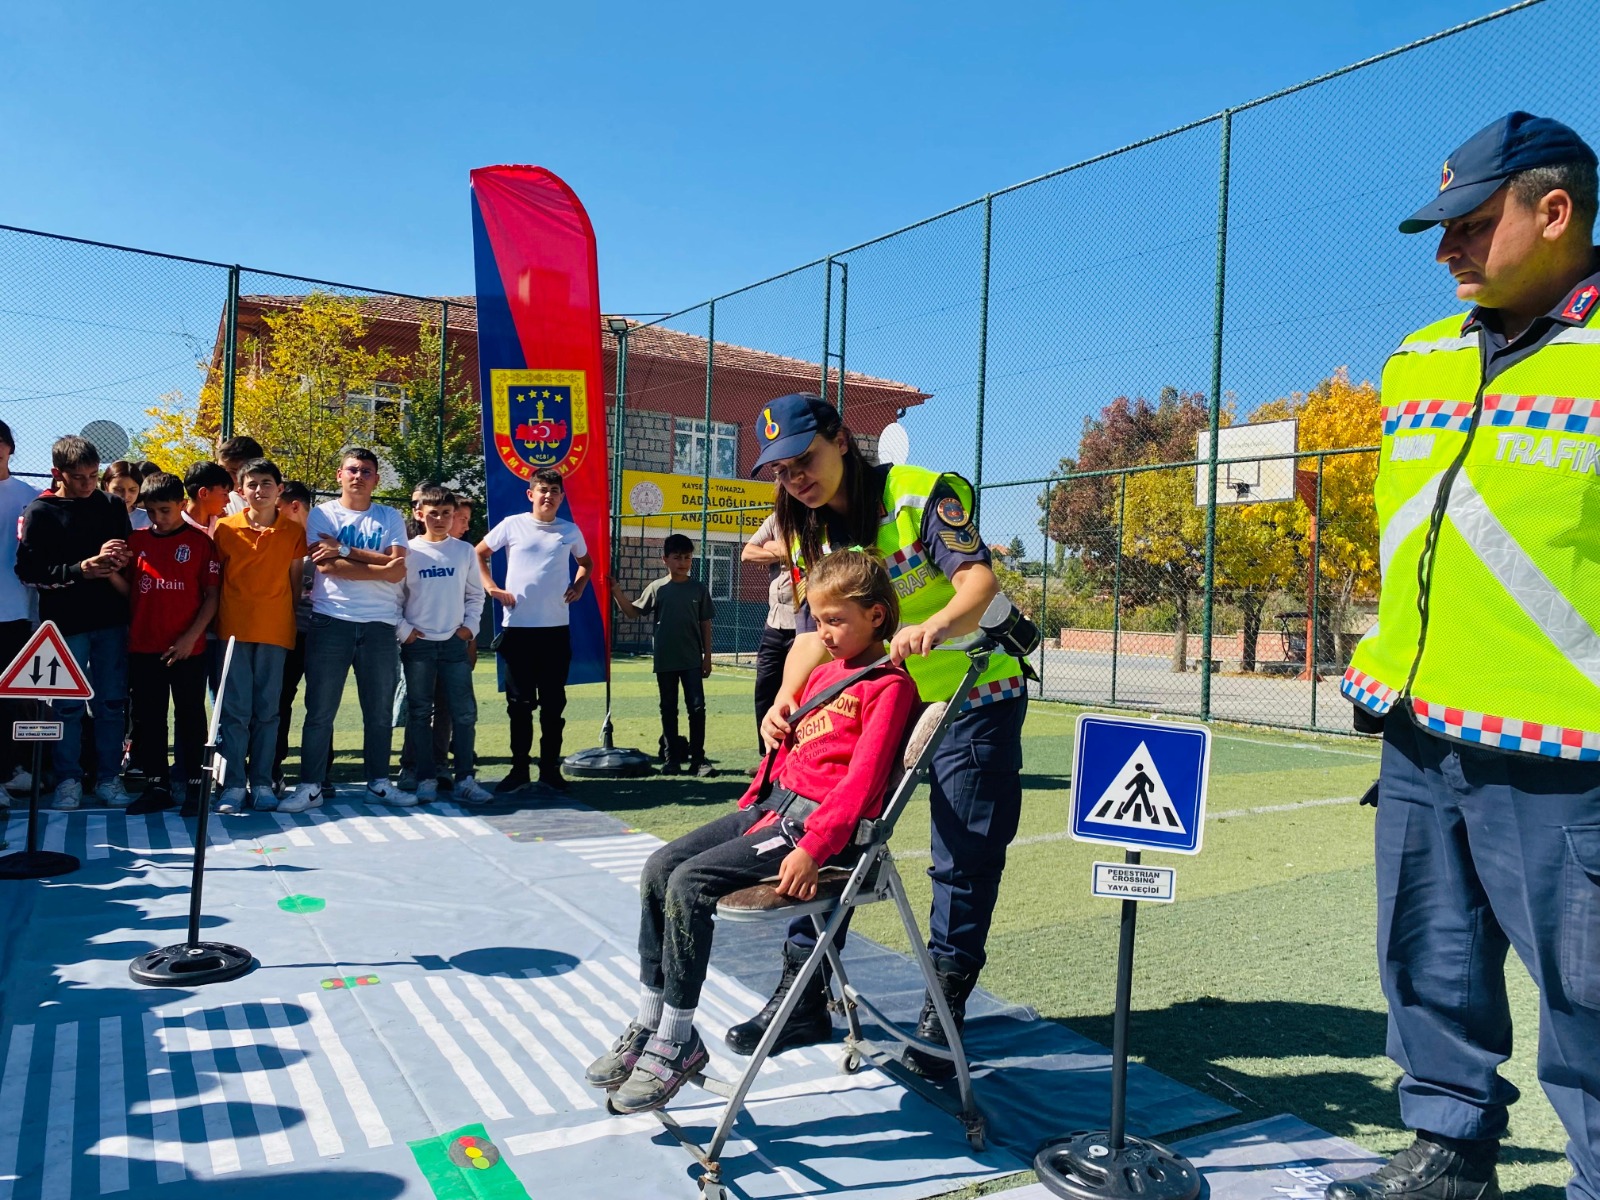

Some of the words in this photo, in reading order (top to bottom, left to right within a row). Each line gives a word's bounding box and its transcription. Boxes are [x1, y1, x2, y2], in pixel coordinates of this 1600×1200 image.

[716, 485, 745, 494] TOMARZA
[419, 566, 455, 579] miav
[156, 578, 185, 590] Rain
[1108, 868, 1160, 879] PEDESTRIAN
[1112, 875, 1155, 884] CROSSING
[1107, 884, 1129, 892] YAYA
[1131, 886, 1160, 895] GEÇİDİ
